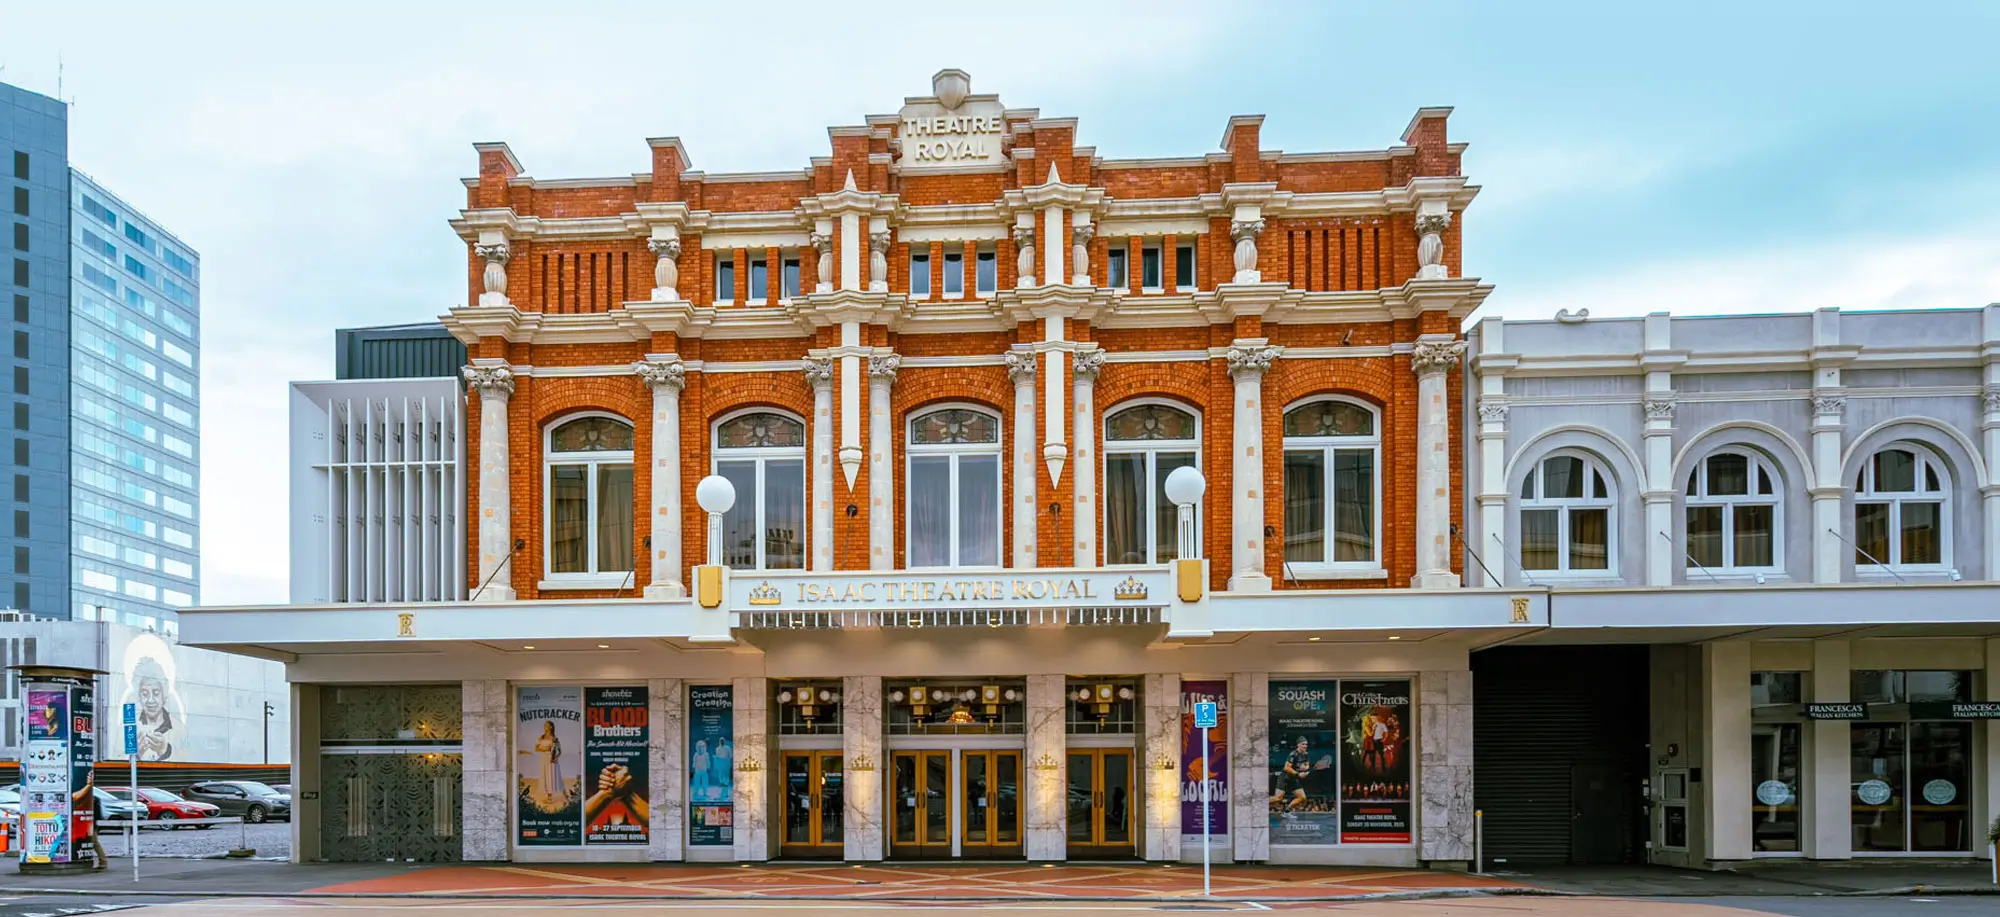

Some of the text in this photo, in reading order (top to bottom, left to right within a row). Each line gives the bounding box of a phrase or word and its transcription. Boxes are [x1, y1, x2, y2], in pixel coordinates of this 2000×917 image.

[904, 116, 1002, 137] THEATRE
[915, 138, 989, 161] ROYAL
[797, 579, 1098, 603] ISAAC THEATRE ROYAL
[691, 691, 729, 699] Creation
[1217, 694, 1227, 710] &
[1278, 690, 1326, 701] SQUASH
[1342, 692, 1409, 708] Christmas
[519, 708, 581, 723] NUTCRACKER
[1202, 704, 1209, 712] P
[1810, 704, 1863, 713] FRANCESCA'S
[587, 706, 648, 728] BLOOD
[593, 724, 641, 737] Brothers
[1181, 779, 1228, 802] LOCAL
